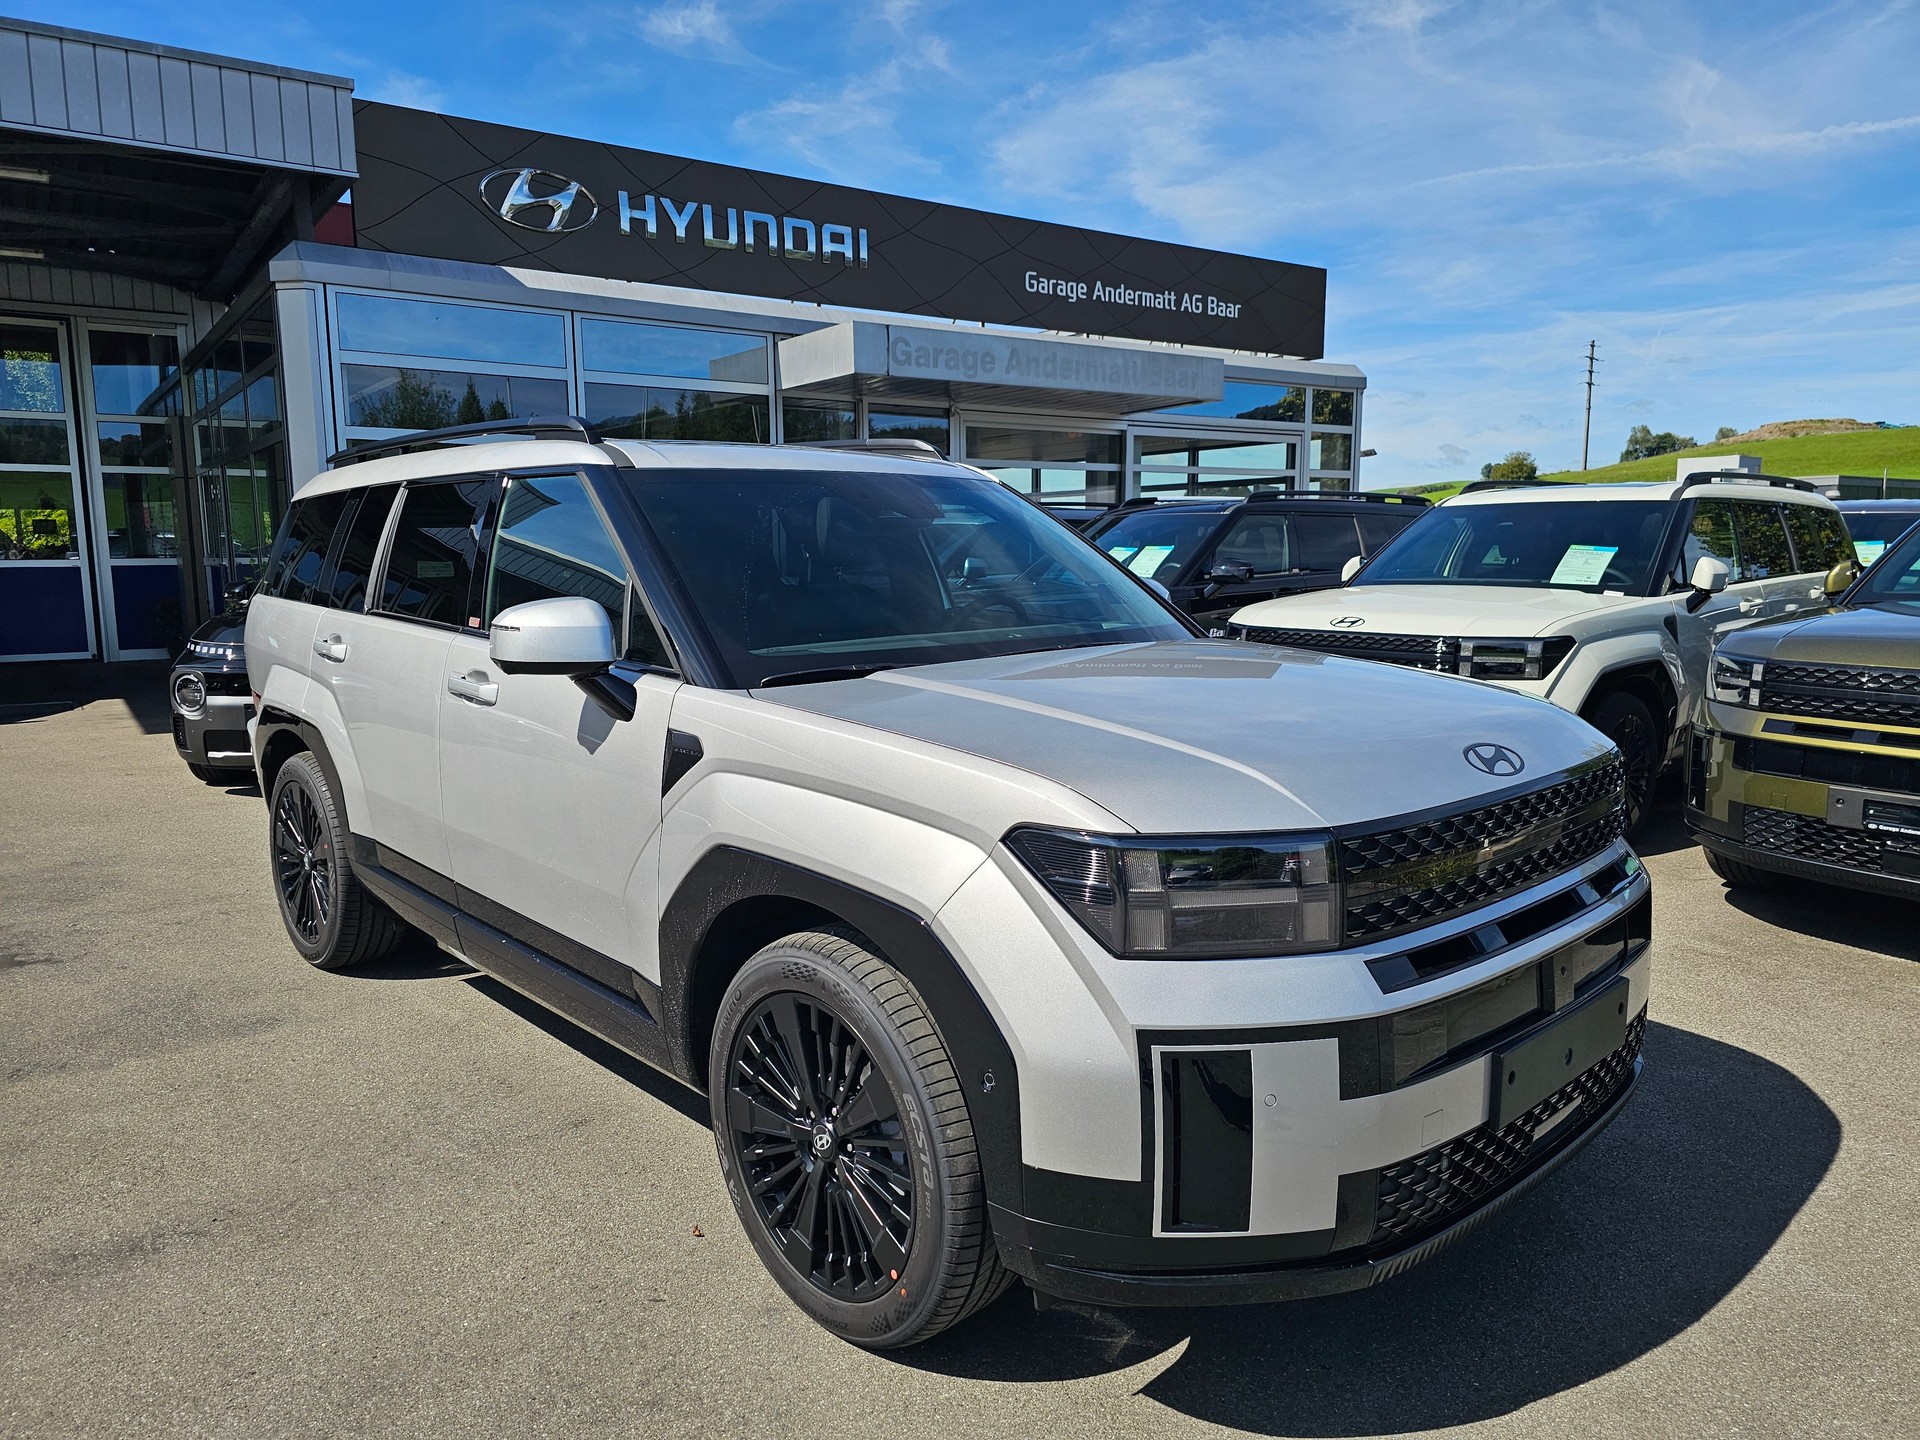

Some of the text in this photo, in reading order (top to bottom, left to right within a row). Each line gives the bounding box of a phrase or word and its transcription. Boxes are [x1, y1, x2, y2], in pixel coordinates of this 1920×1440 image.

[617, 190, 869, 269] HYUNDAI
[1024, 271, 1243, 319] Garage Andermatt AG Baar
[890, 335, 997, 379] Garage
